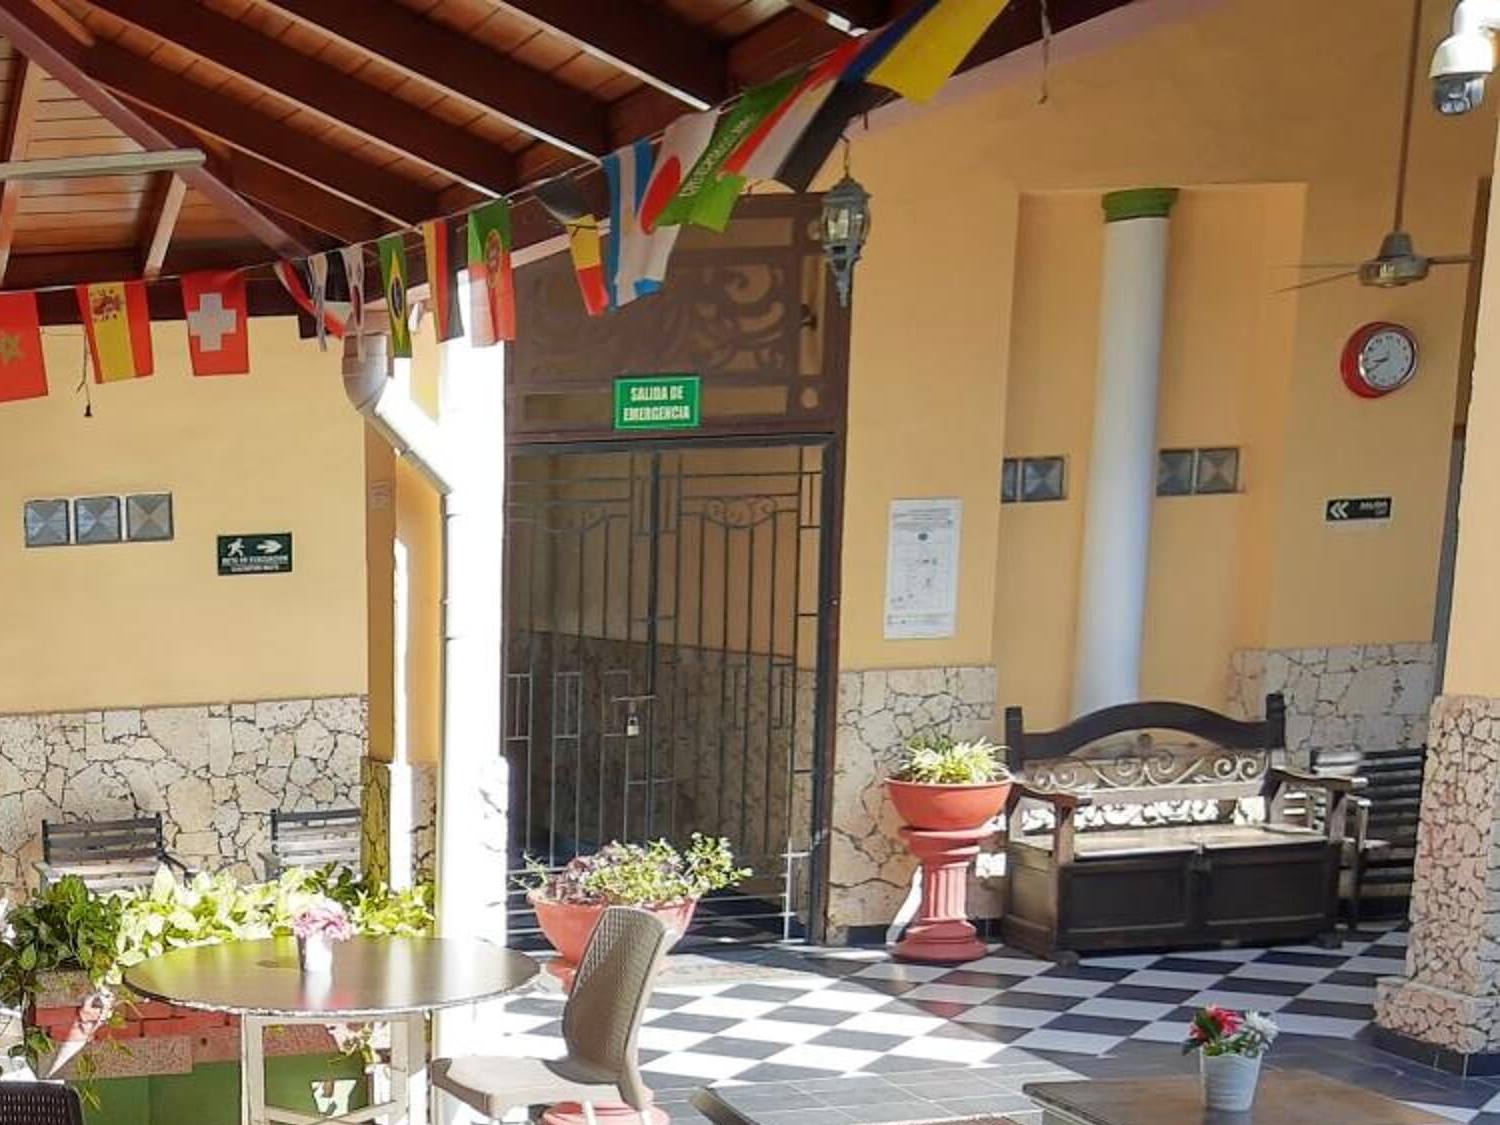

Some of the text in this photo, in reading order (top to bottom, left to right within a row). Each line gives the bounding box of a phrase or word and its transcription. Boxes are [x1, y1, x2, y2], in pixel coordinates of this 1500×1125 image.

[630, 384, 685, 402] SALIDA DE
[623, 405, 691, 422] EMERGENCIA
